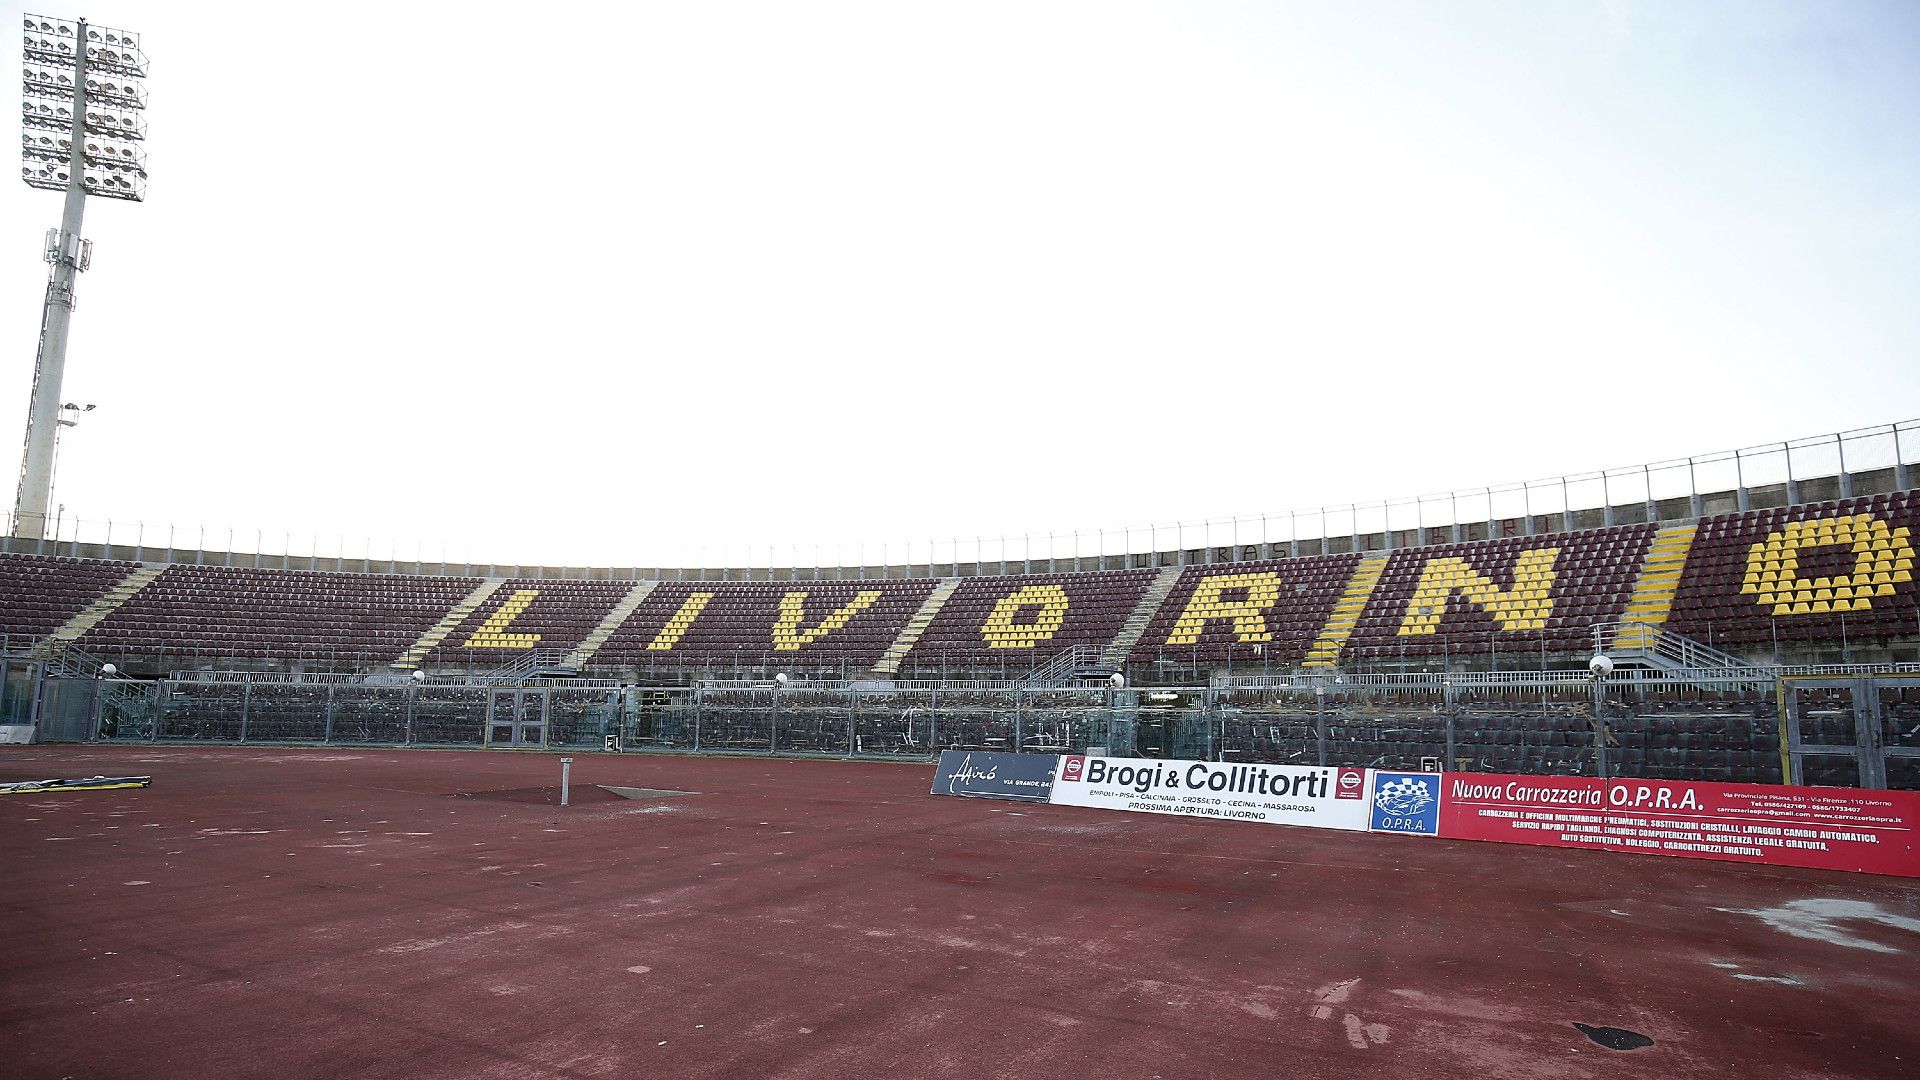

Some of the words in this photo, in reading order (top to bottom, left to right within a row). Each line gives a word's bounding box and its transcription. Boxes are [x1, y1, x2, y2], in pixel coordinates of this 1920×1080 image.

[1136, 544, 1286, 567] ULTRAS
[1367, 516, 1549, 550] LIBERI
[1087, 759, 1162, 793] Brogi
[1165, 770, 1179, 788] &
[1185, 763, 1329, 798] Collitorti
[1140, 794, 1176, 802] CALCINAIA
[1183, 797, 1221, 805] GROSSETO
[1228, 800, 1256, 808] CECINA
[1263, 803, 1316, 812] MASSAROSA
[1452, 779, 1502, 800] Nuova
[1506, 782, 1602, 805] Carrozzeria
[1610, 785, 1704, 811] O.P.R.A.
[1128, 802, 1172, 812] PROSSIMA
[1173, 806, 1223, 816] APERTURA:
[1223, 809, 1266, 819] LIVORNO
[1478, 809, 1519, 818] CARROZZERIA
[1525, 812, 1554, 820] OFFICINA
[1554, 814, 1603, 823] MULTIMARCHE
[1650, 819, 1699, 830] SOSTITUZIONI
[1743, 826, 1781, 835] LAVAGGIO
[1783, 828, 1817, 838] CAMBIO
[1382, 817, 1426, 831] O.P.R.A.
[1512, 821, 1540, 830] SERVIZIO
[1541, 823, 1564, 831] RAPIDO
[1604, 828, 1637, 836] DIAGNOSI
[1706, 835, 1752, 845] ASSISTENZA
[1755, 838, 1784, 847] LEGALE
[1663, 842, 1721, 853] CARROATTREZZI
